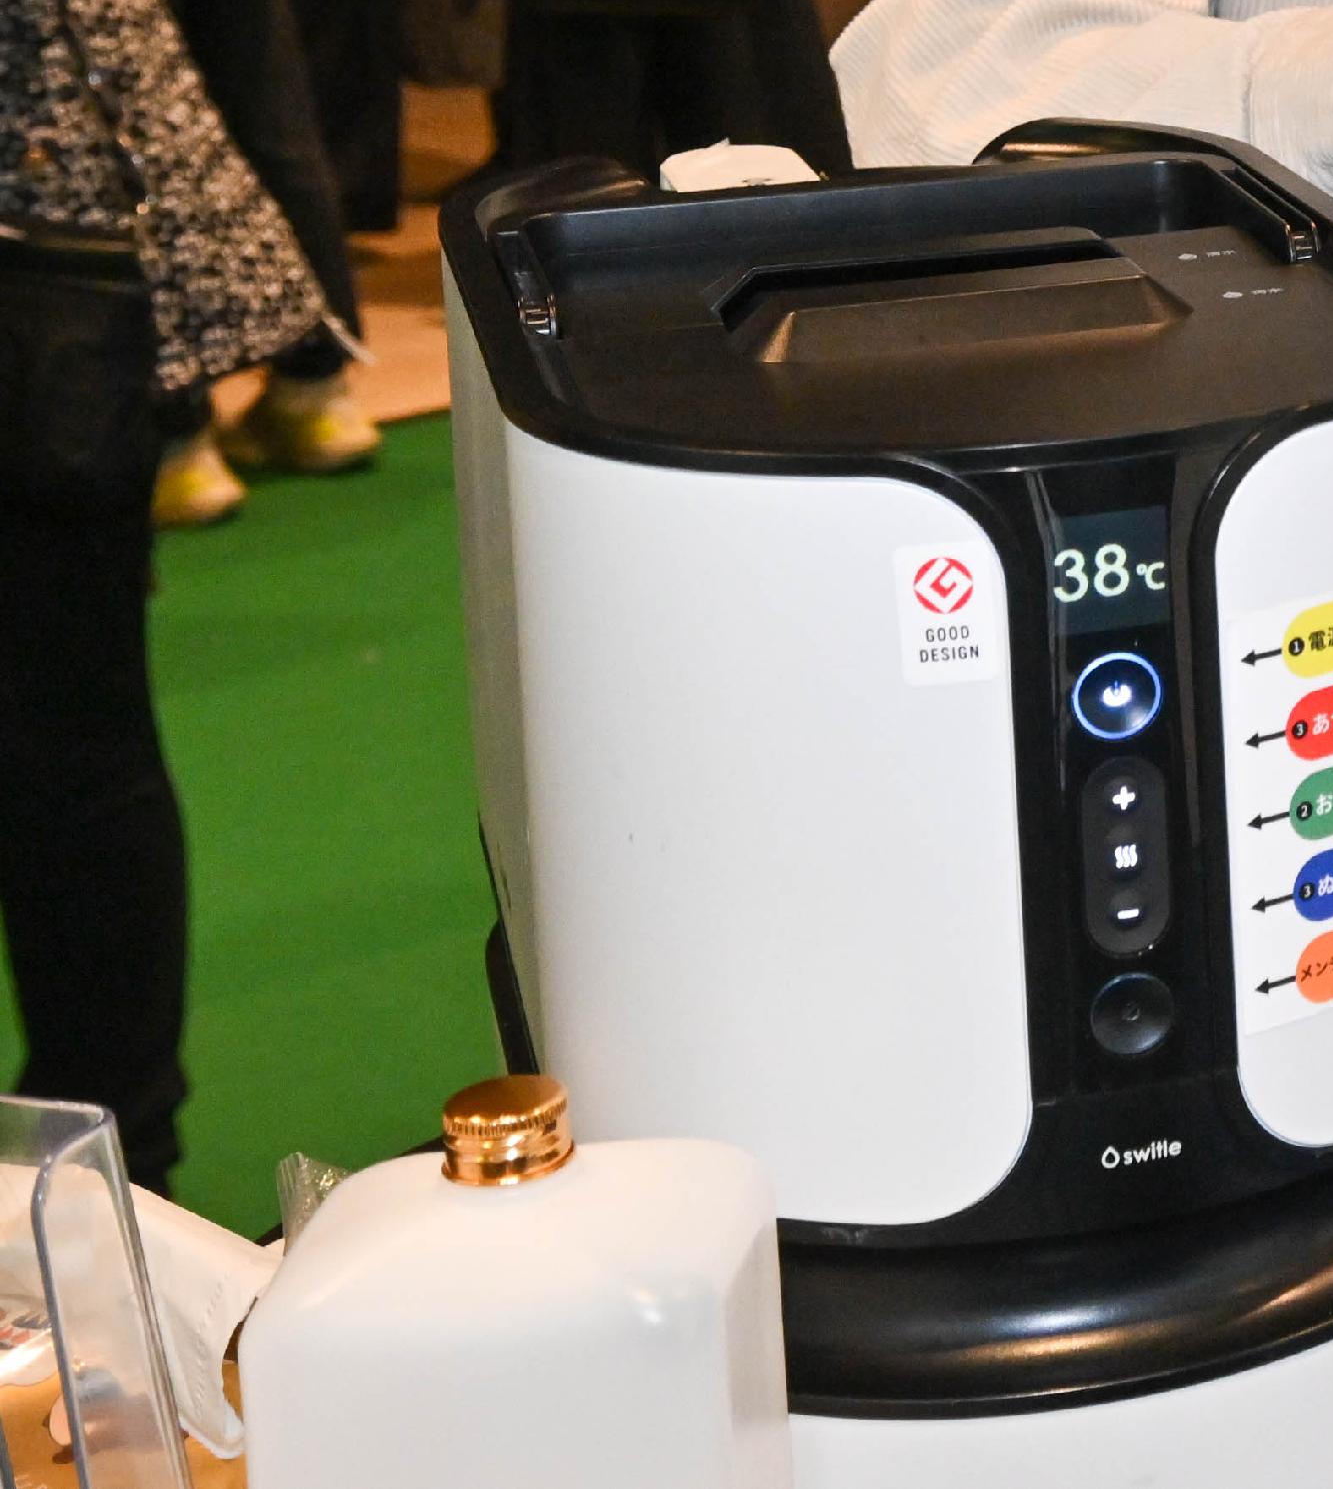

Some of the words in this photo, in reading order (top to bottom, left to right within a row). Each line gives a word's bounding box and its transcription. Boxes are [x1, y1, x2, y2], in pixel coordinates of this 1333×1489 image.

[925, 625, 970, 643] GOOD
[919, 644, 979, 663] DESIGN
[1123, 1137, 1182, 1166] switle
